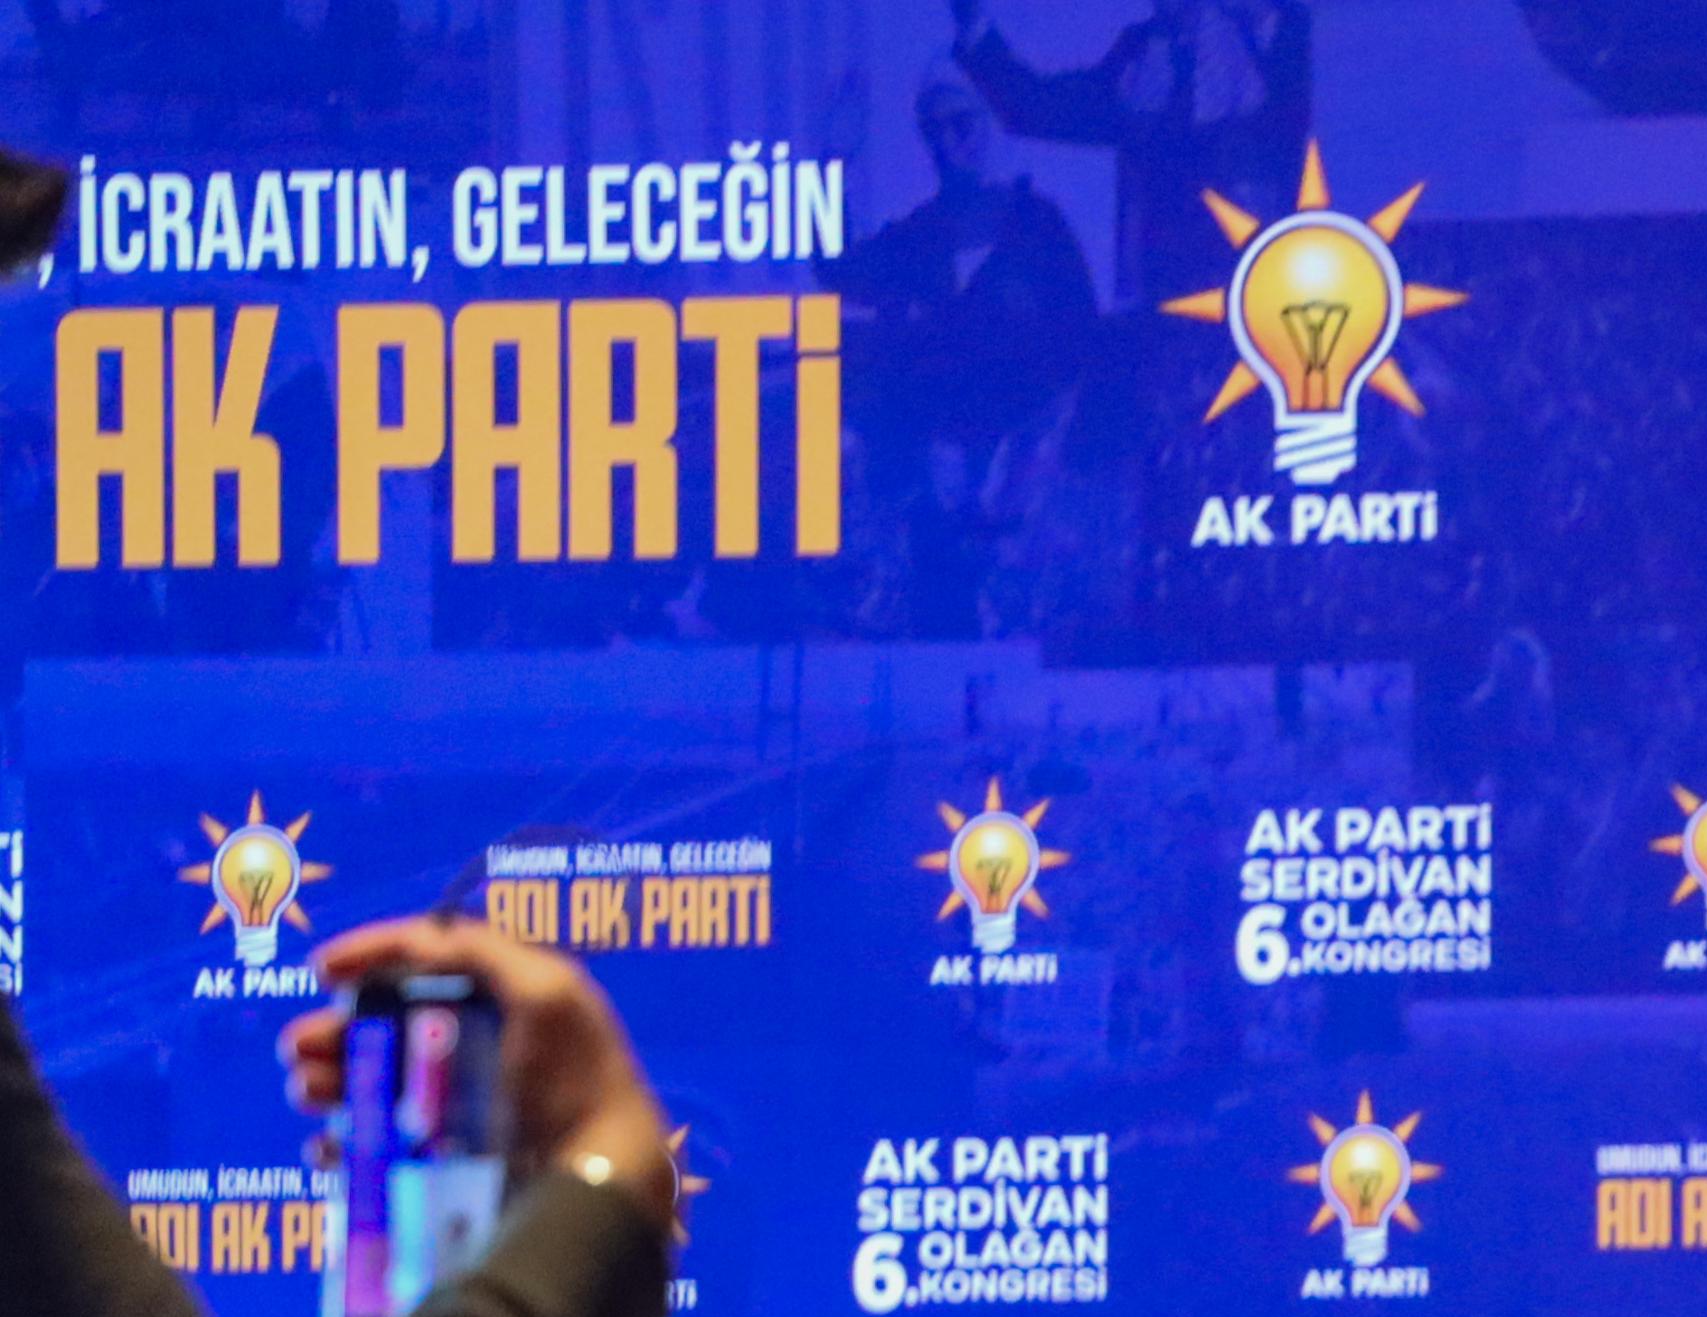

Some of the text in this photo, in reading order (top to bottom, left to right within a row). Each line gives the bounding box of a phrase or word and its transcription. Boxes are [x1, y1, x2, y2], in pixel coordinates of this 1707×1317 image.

[78, 139, 844, 284] İCRAATIN, GELECEĞİN
[54, 303, 283, 570] AK
[1190, 496, 1274, 547] AK
[1244, 808, 1323, 855] AK
[1240, 848, 1492, 901] SERDİVAN
[569, 876, 631, 948] AK
[1235, 894, 1492, 986] 6. OLAĞAN
[1662, 939, 1707, 970] AK
[192, 967, 235, 999] AK
[929, 955, 972, 985] AK
[863, 1138, 940, 1185] AK
[857, 1176, 1108, 1232] SERDİVAN
[1596, 1176, 1673, 1249] ADI
[211, 1200, 271, 1274] AK
[853, 1224, 1108, 1314] 6. OLAĞAN
[1300, 1268, 1345, 1298] AK
